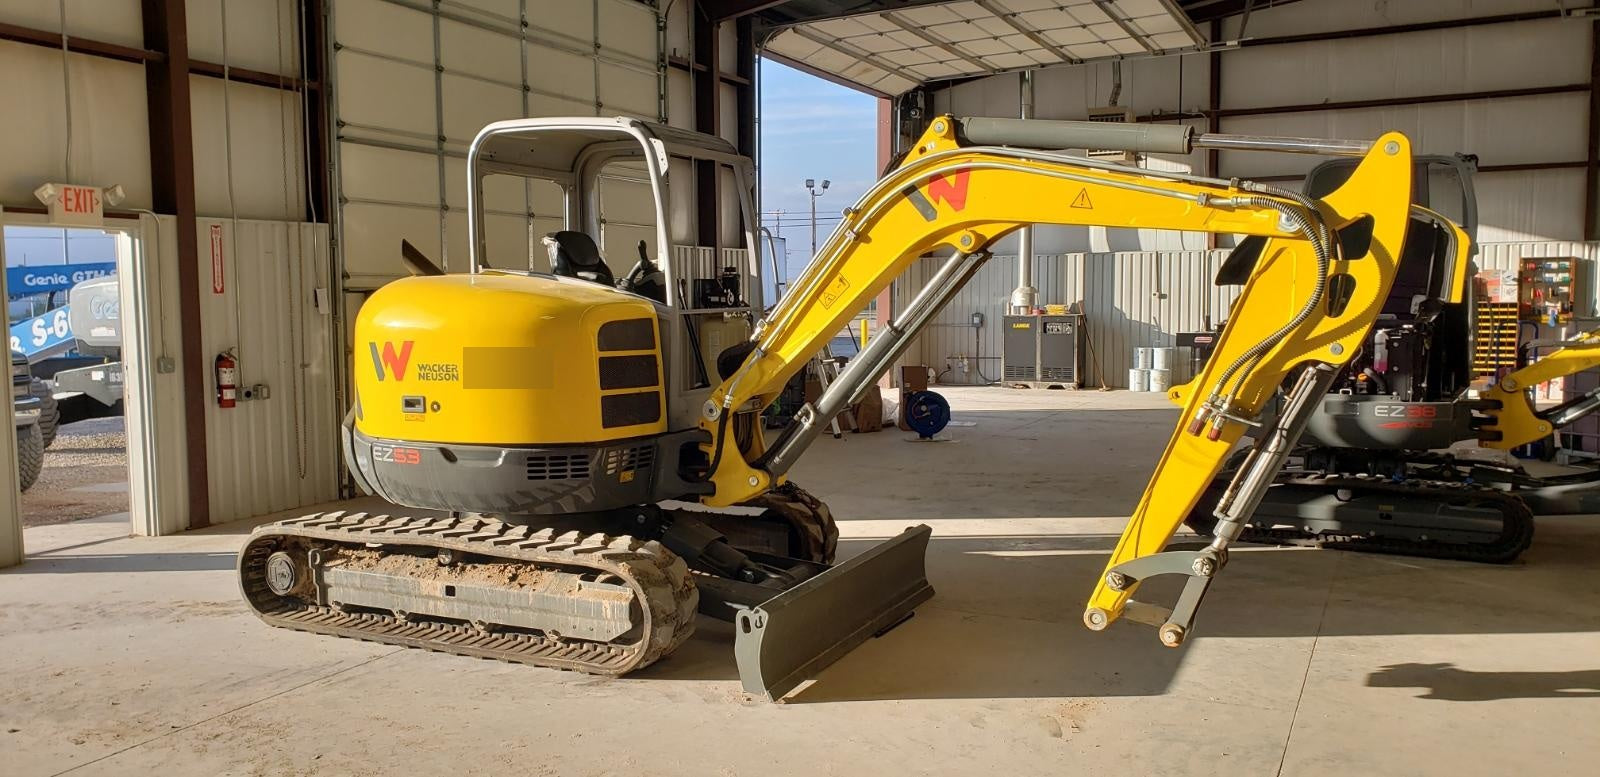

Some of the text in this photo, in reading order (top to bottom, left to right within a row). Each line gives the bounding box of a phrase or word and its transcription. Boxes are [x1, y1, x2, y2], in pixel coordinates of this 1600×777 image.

[63, 187, 95, 213] EXIT
[24, 273, 70, 286] Genie
[32, 310, 73, 347] S-6
[417, 363, 459, 373] WACKER
[418, 373, 459, 382] NEUSON
[1374, 405, 1436, 417] EZ38
[373, 446, 420, 464] EZ53
